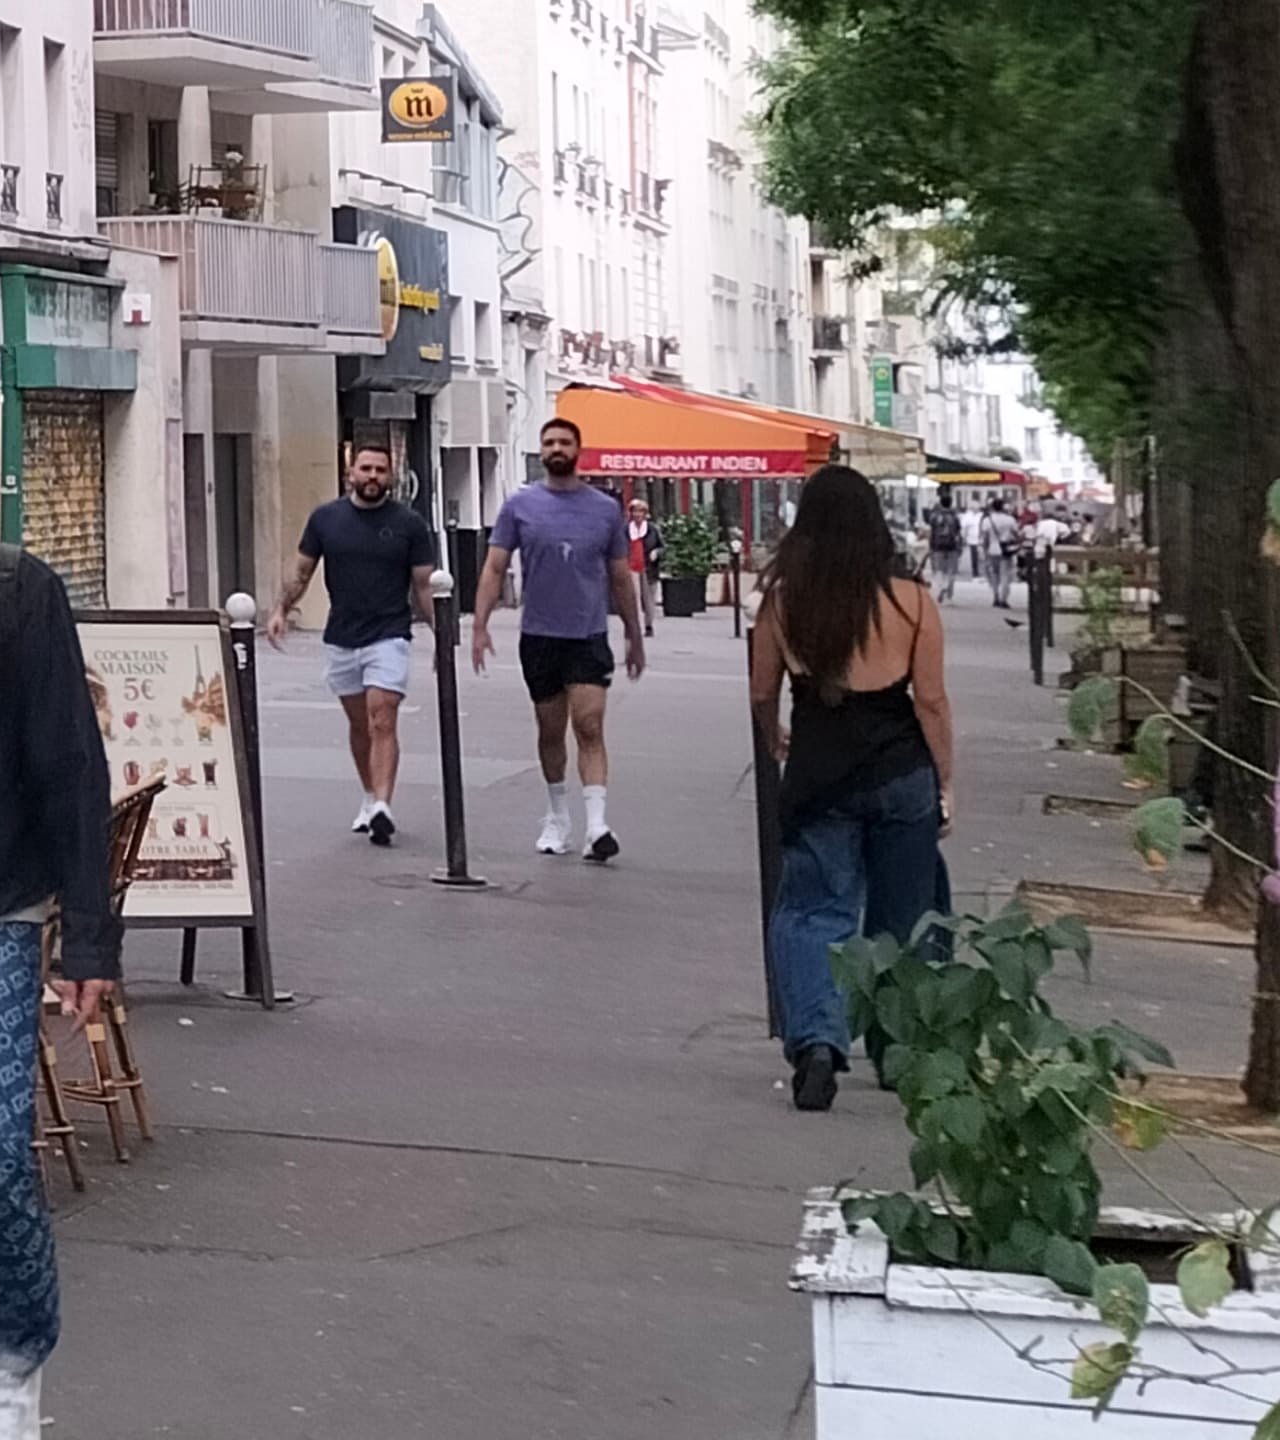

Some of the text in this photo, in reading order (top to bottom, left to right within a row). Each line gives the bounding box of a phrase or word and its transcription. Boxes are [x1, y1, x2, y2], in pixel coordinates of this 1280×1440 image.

[600, 453, 769, 472] RESTAURANT INDIEN
[93, 649, 169, 662] COCKTAILS
[100, 662, 167, 675] MAISON
[123, 677, 157, 702] 5€
